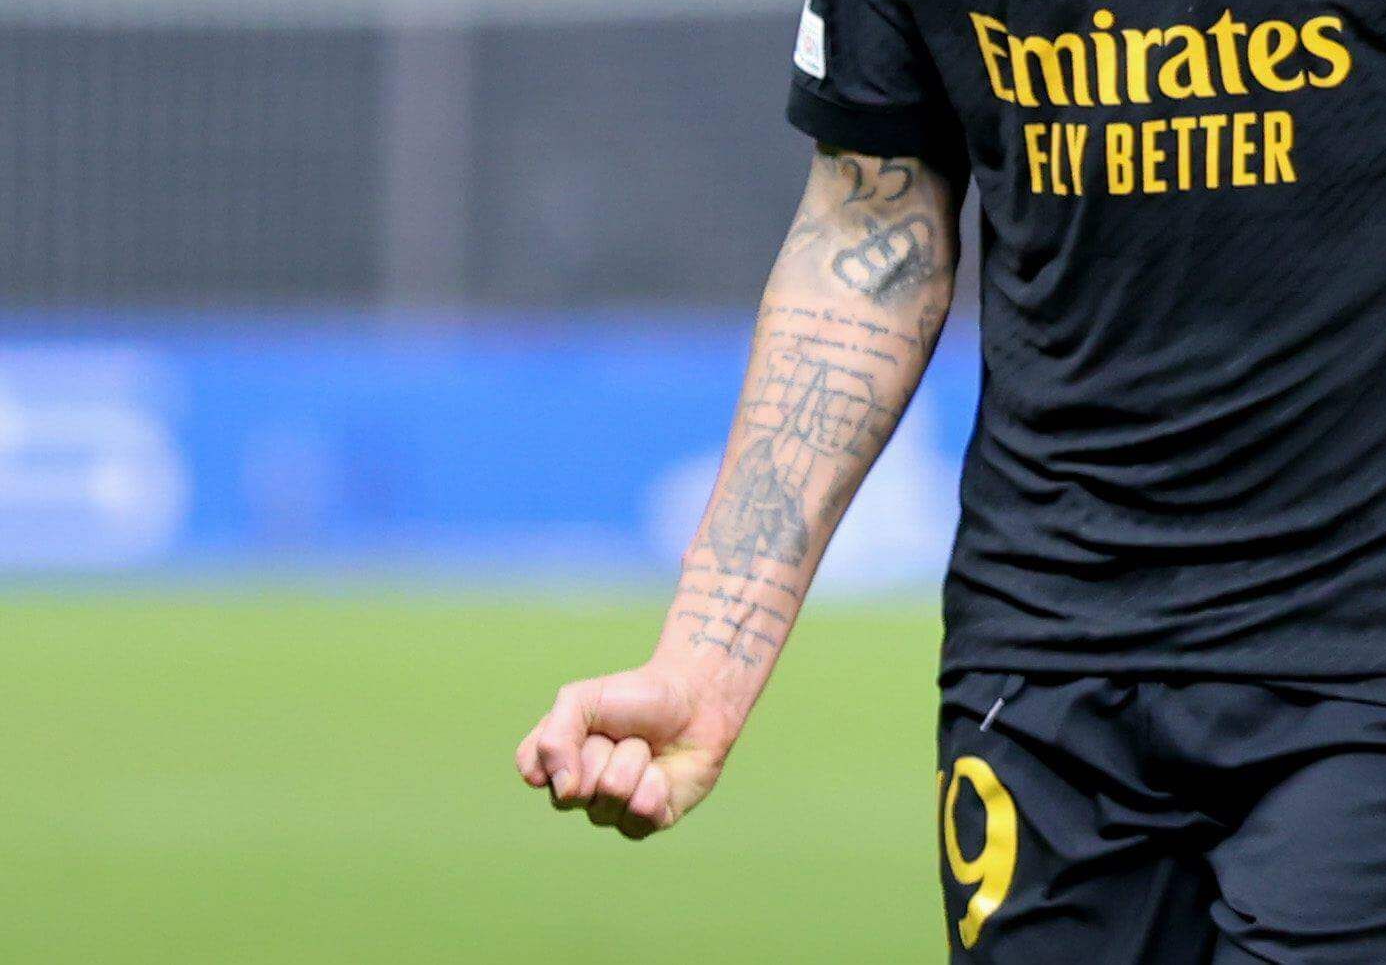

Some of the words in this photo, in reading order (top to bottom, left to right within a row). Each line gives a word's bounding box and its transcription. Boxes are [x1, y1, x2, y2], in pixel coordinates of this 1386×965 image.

[969, 8, 1352, 107] Emirates
[1024, 122, 1089, 196] FLY
[1106, 110, 1297, 195] BETTER
[936, 755, 1019, 950] 9
